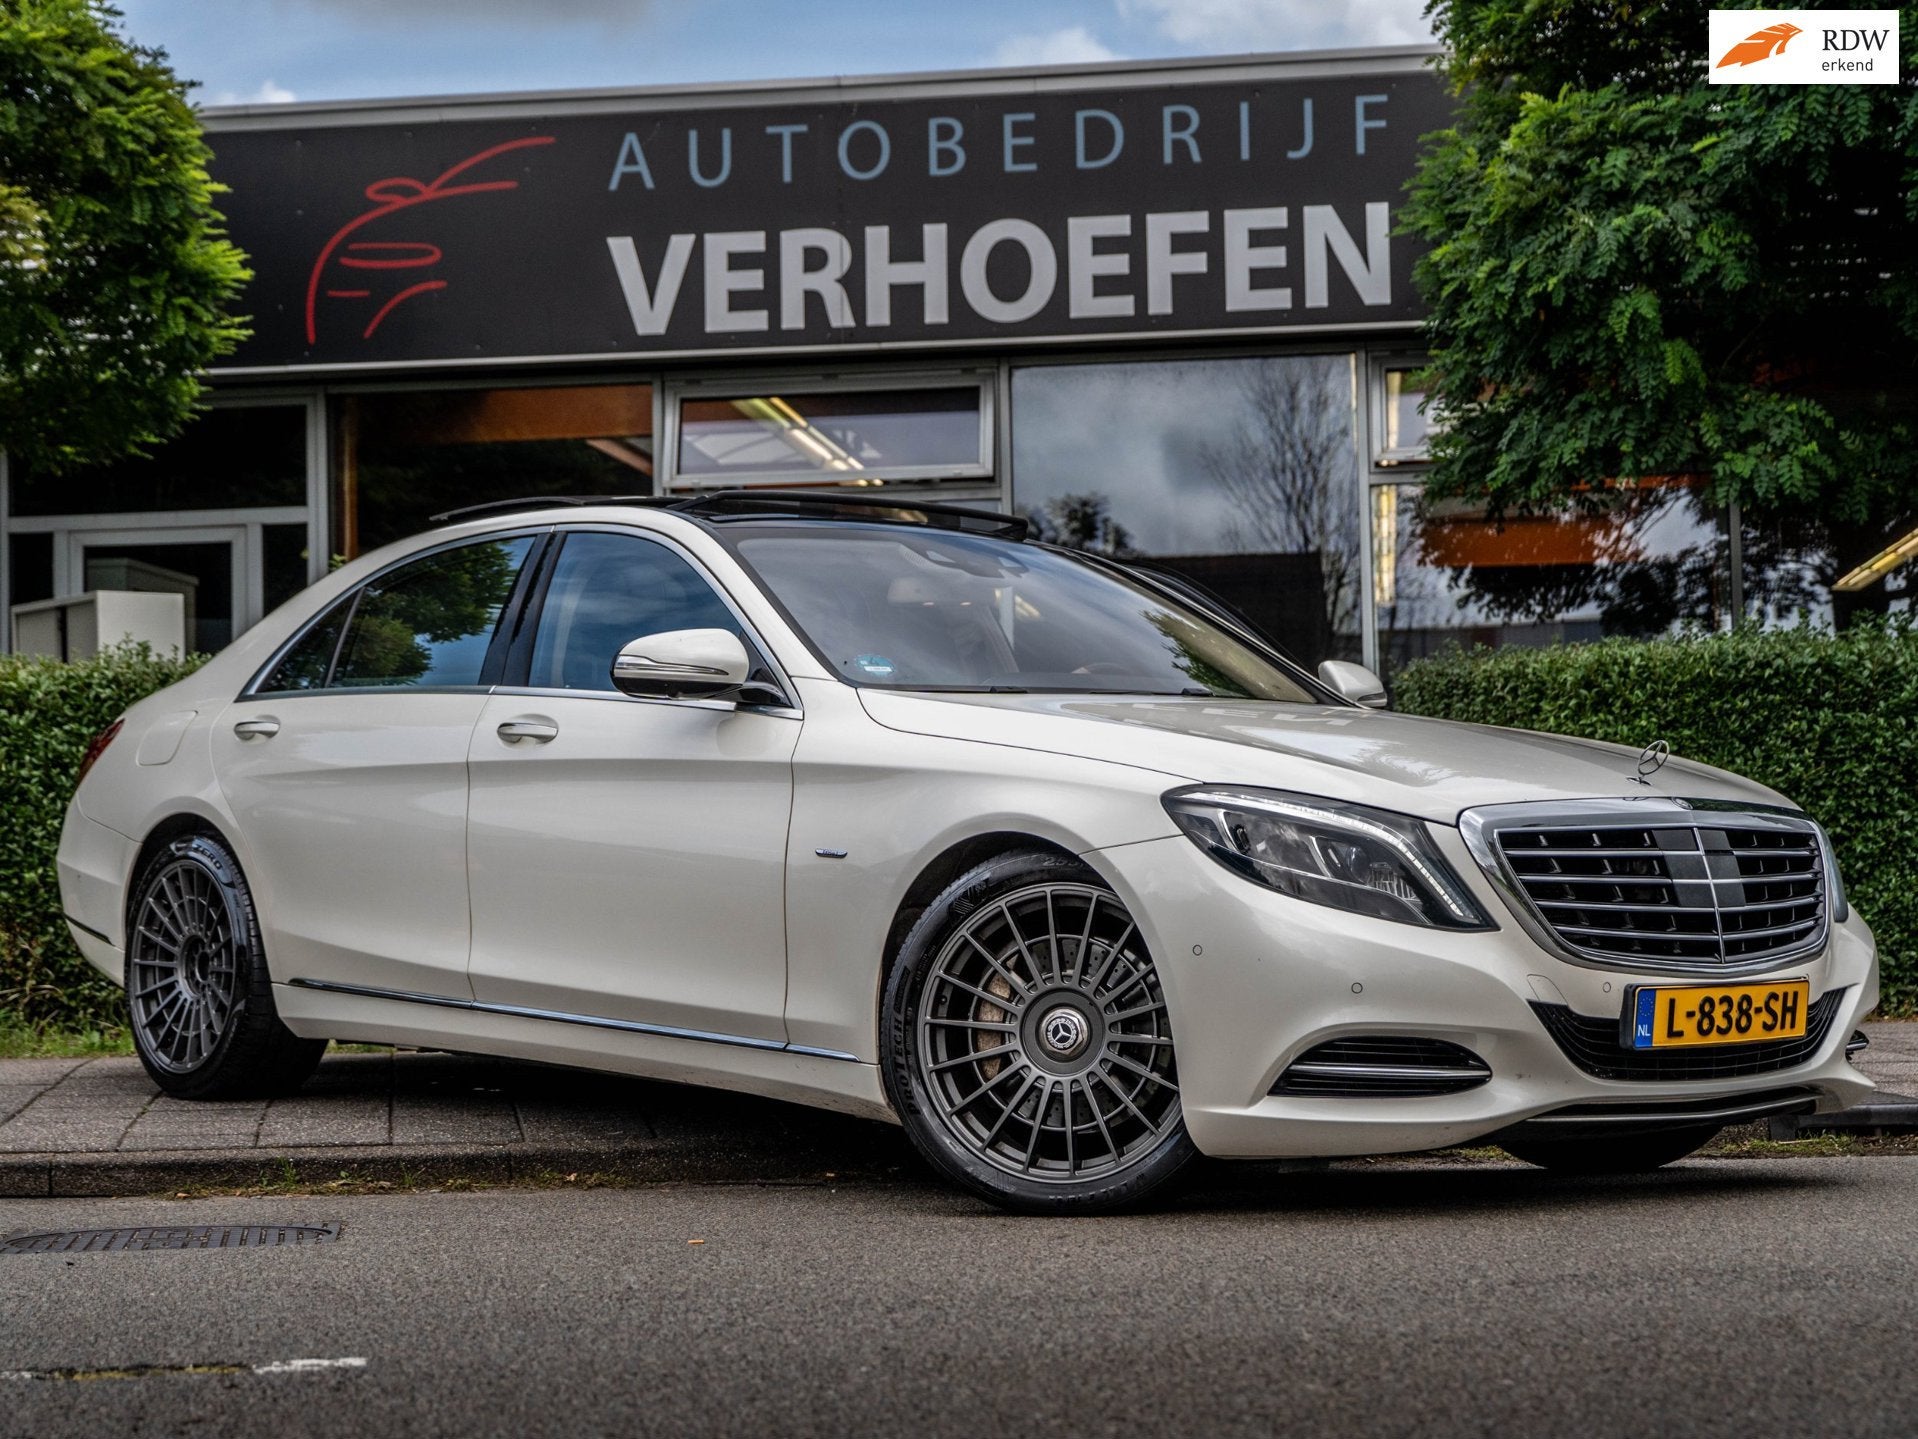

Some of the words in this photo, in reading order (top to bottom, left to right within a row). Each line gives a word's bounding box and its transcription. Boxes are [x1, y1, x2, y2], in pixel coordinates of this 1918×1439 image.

[608, 94, 1390, 191] AUTOBEDRIJF
[606, 201, 1392, 336] VERHOEFEN
[1637, 1024, 1651, 1037] NL
[1666, 991, 1799, 1039] L-838-SH
